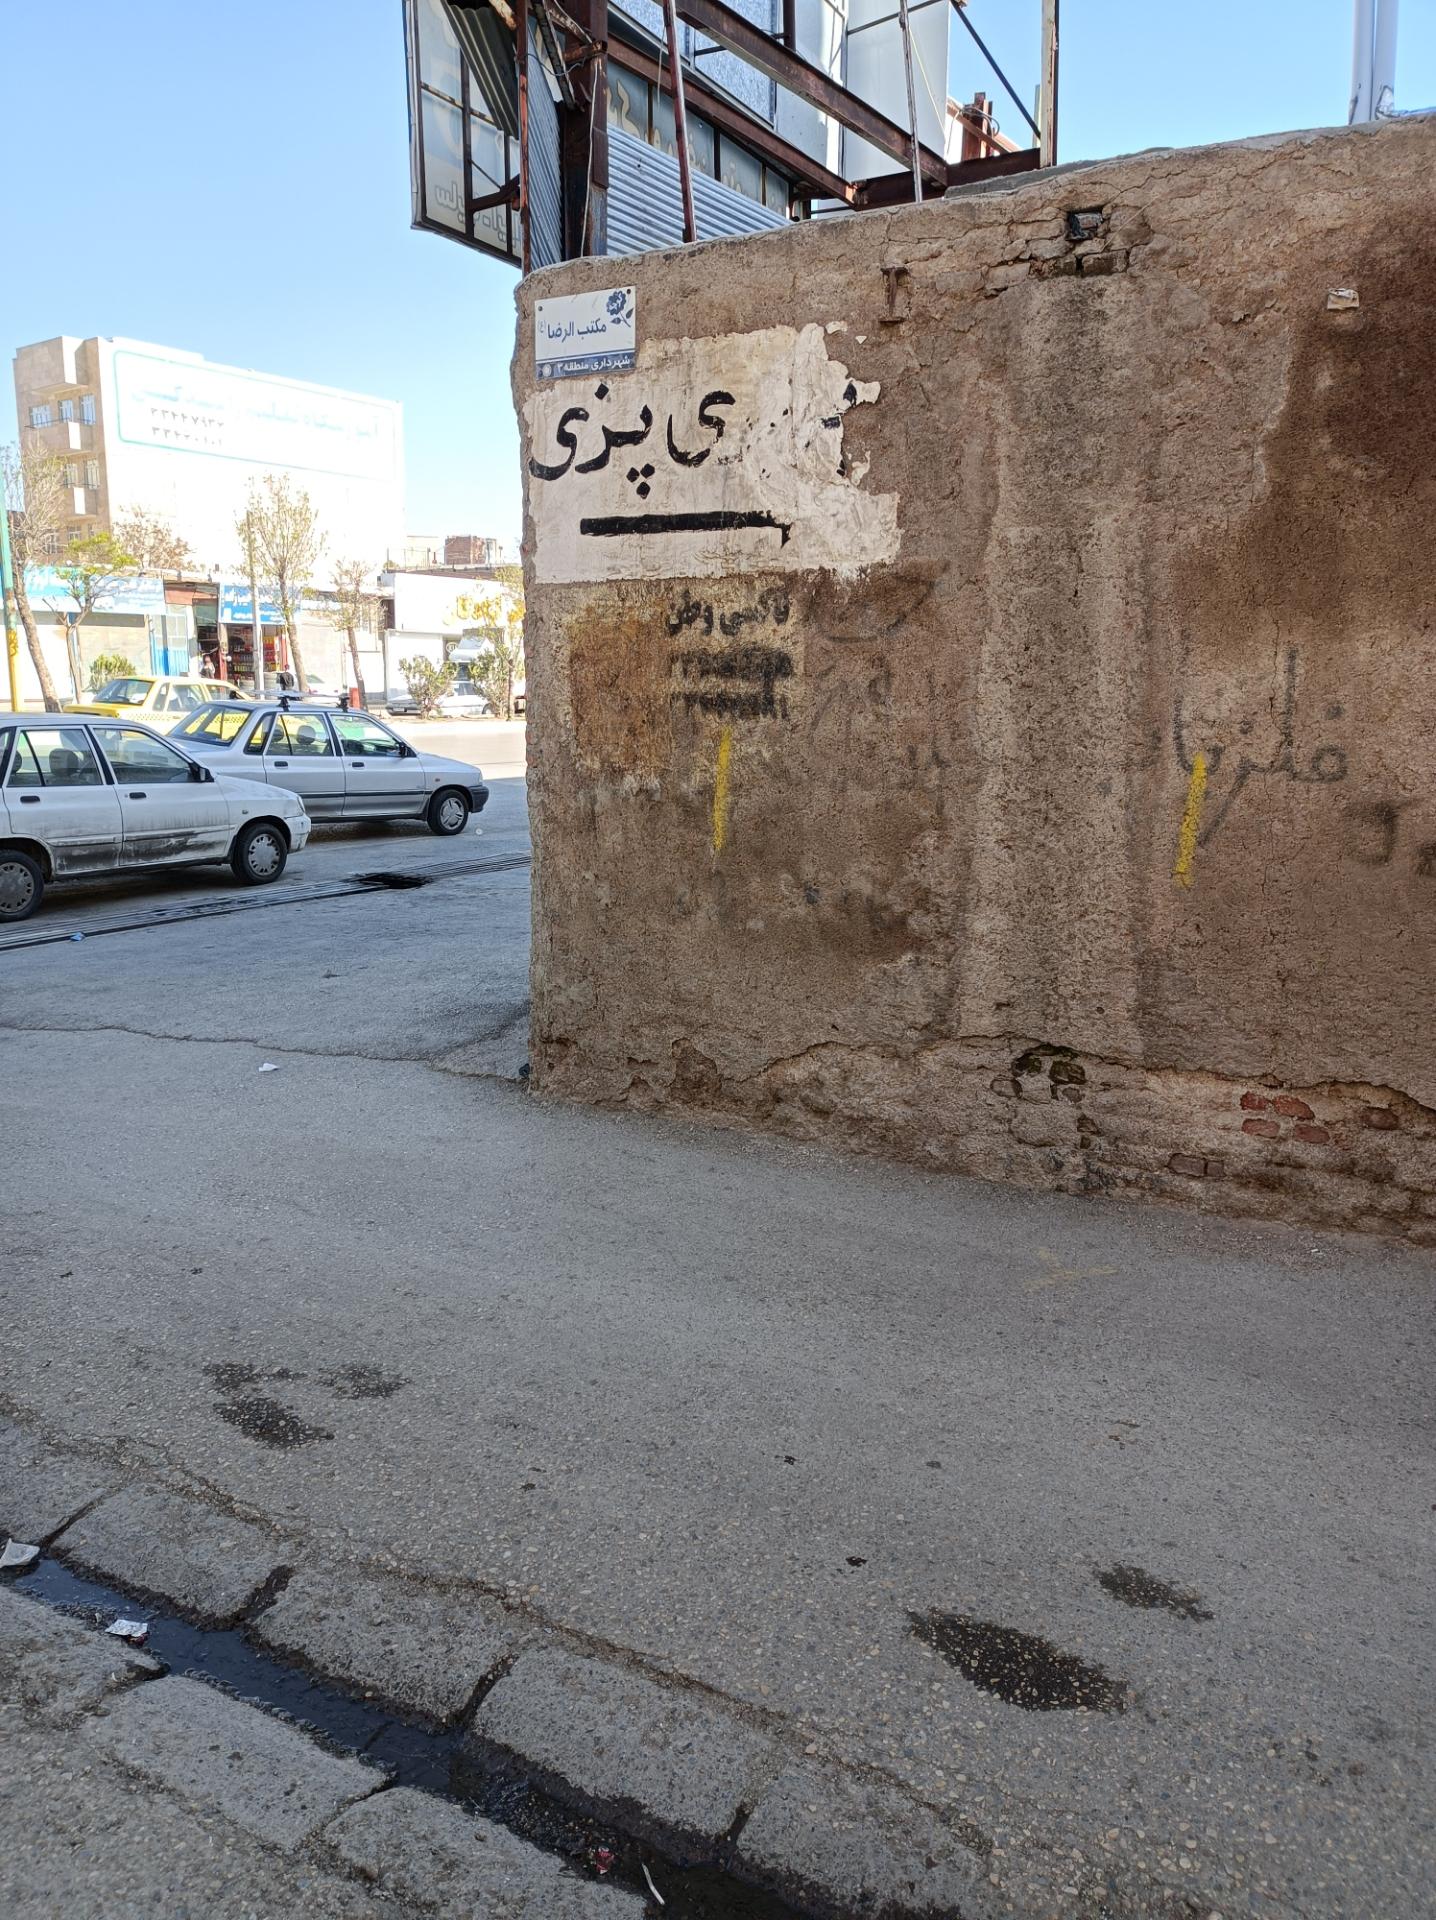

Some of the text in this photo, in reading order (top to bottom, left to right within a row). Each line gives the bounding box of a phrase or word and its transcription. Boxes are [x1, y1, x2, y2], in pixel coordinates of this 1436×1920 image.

[547, 320, 575, 343] الرضا
[577, 317, 607, 340] مکتب
[591, 355, 631, 371] شهرداری
[528, 382, 654, 499] پزی
